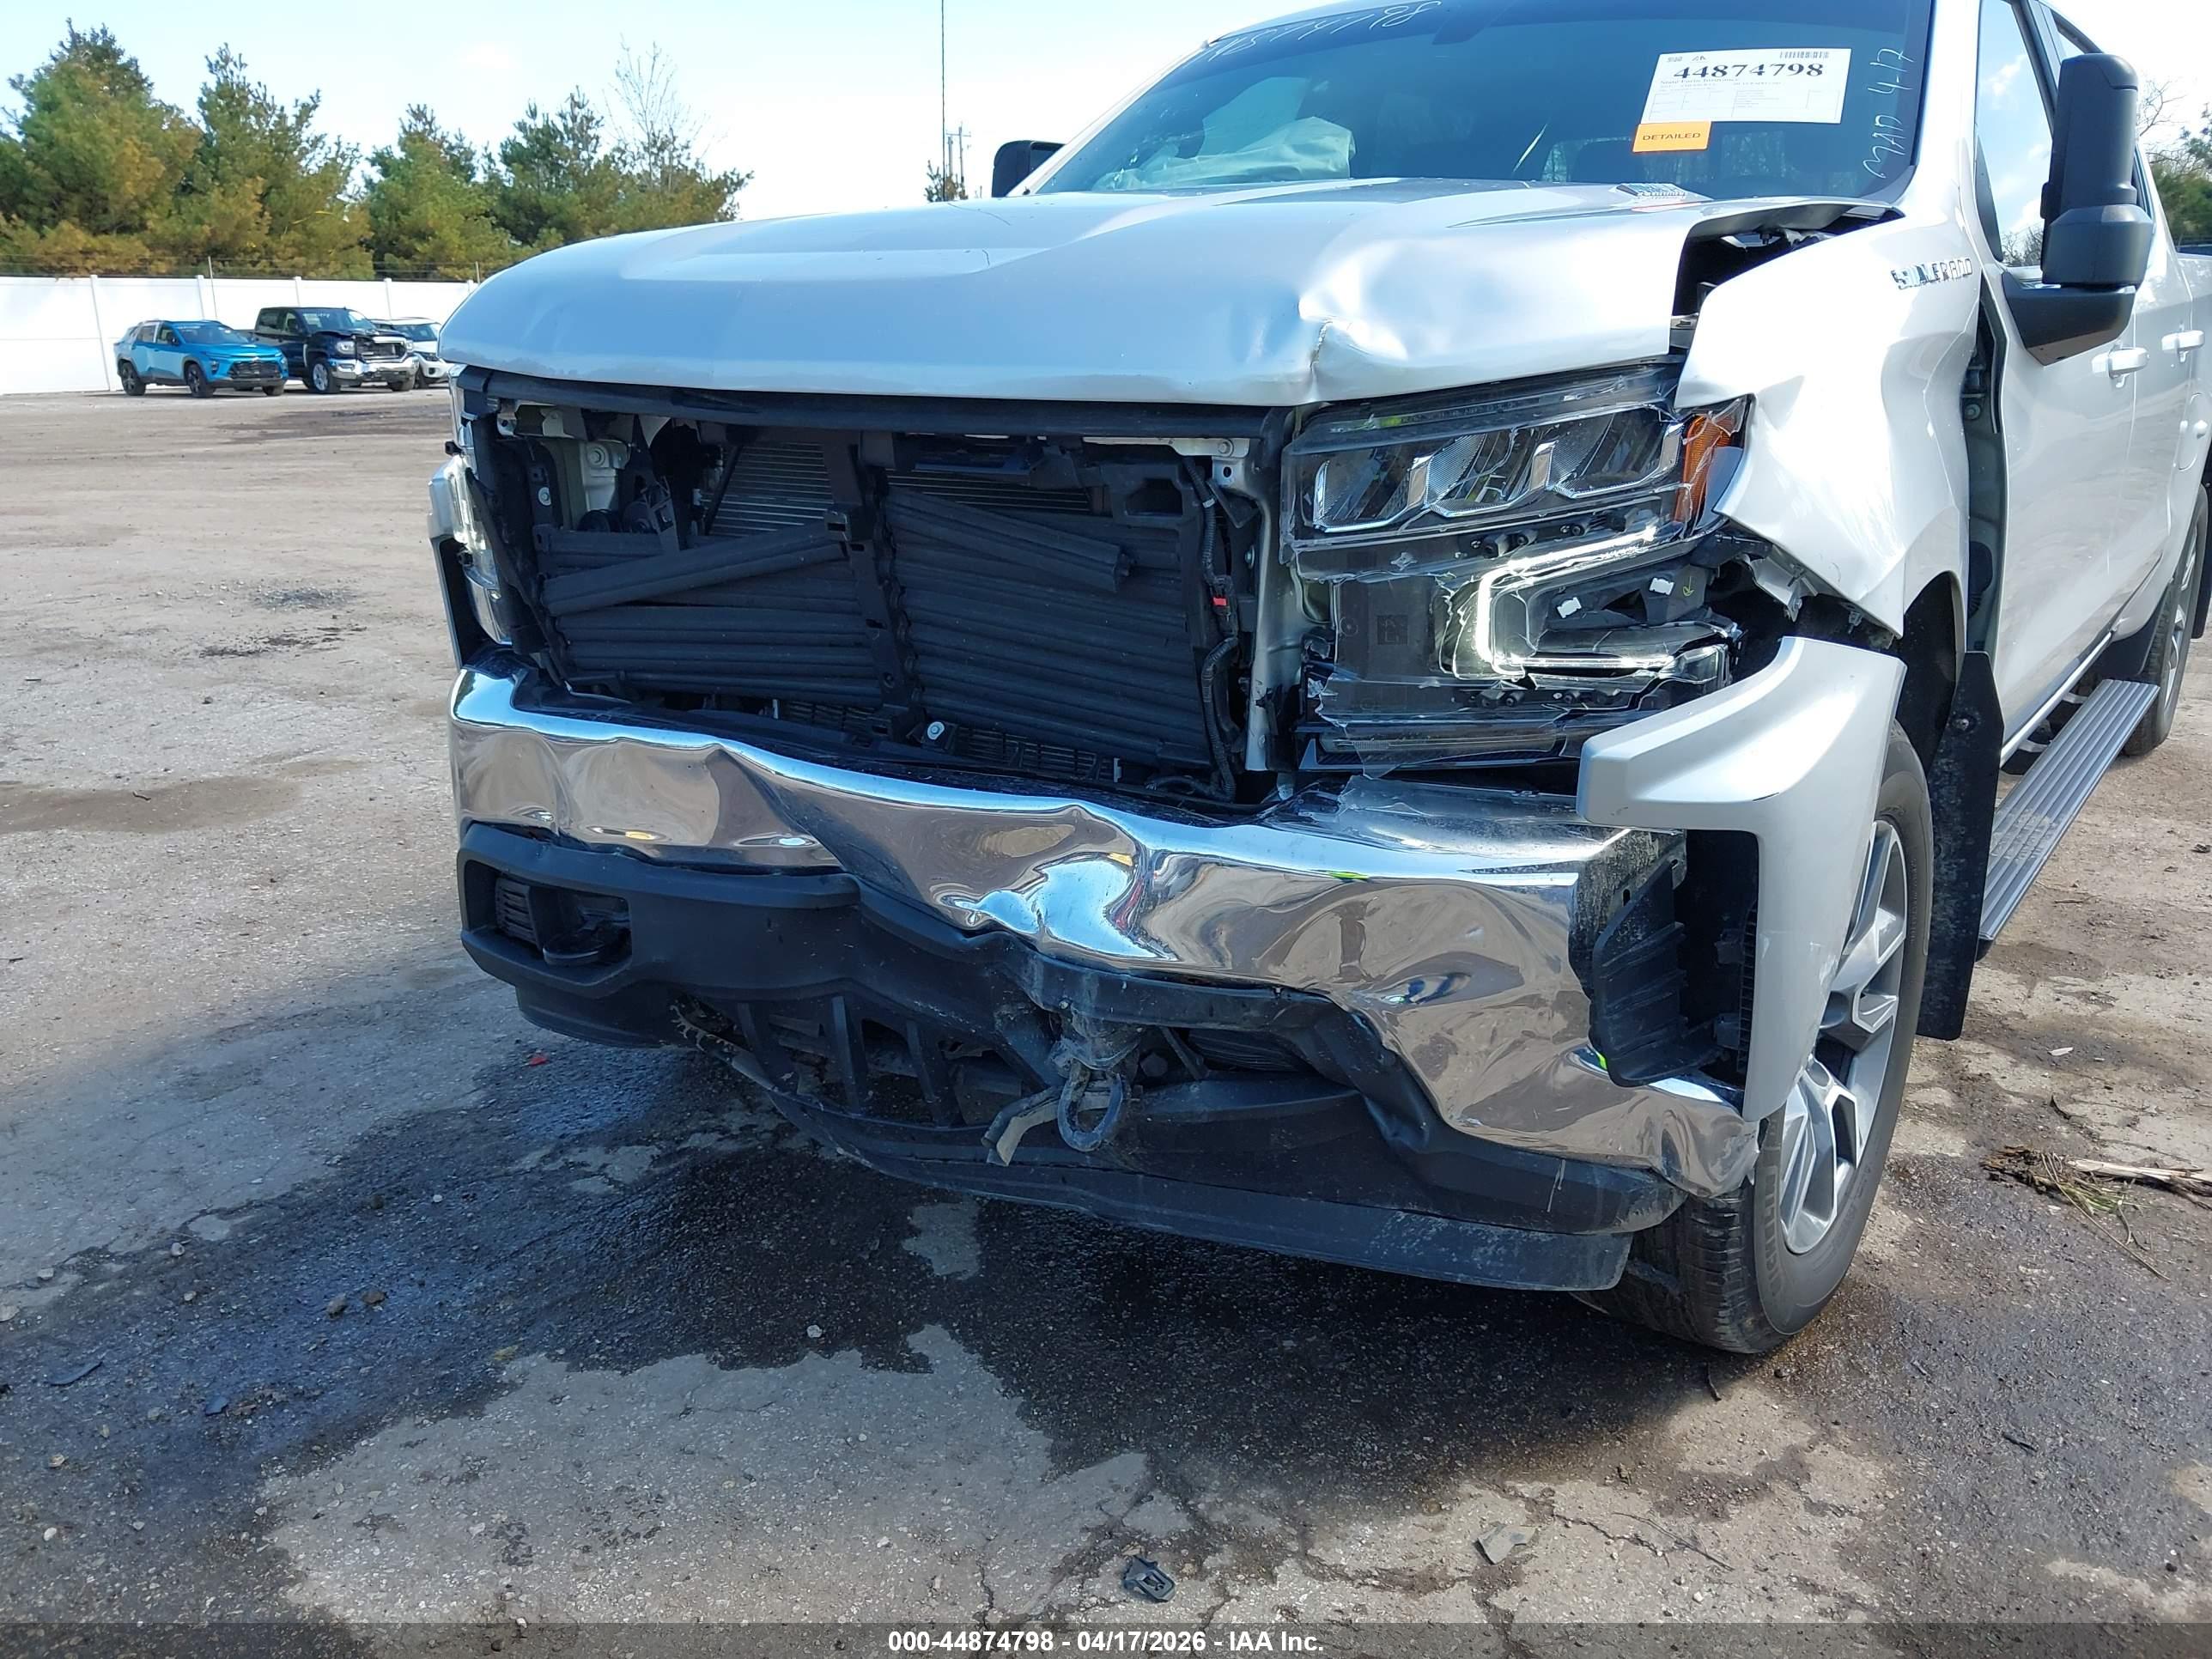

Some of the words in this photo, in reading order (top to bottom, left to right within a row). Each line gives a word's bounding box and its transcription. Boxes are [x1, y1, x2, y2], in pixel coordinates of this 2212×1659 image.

[1673, 63, 1824, 79] 44874798
[1867, 48, 1915, 94] 4-17
[1642, 132, 1701, 141] DETAILED
